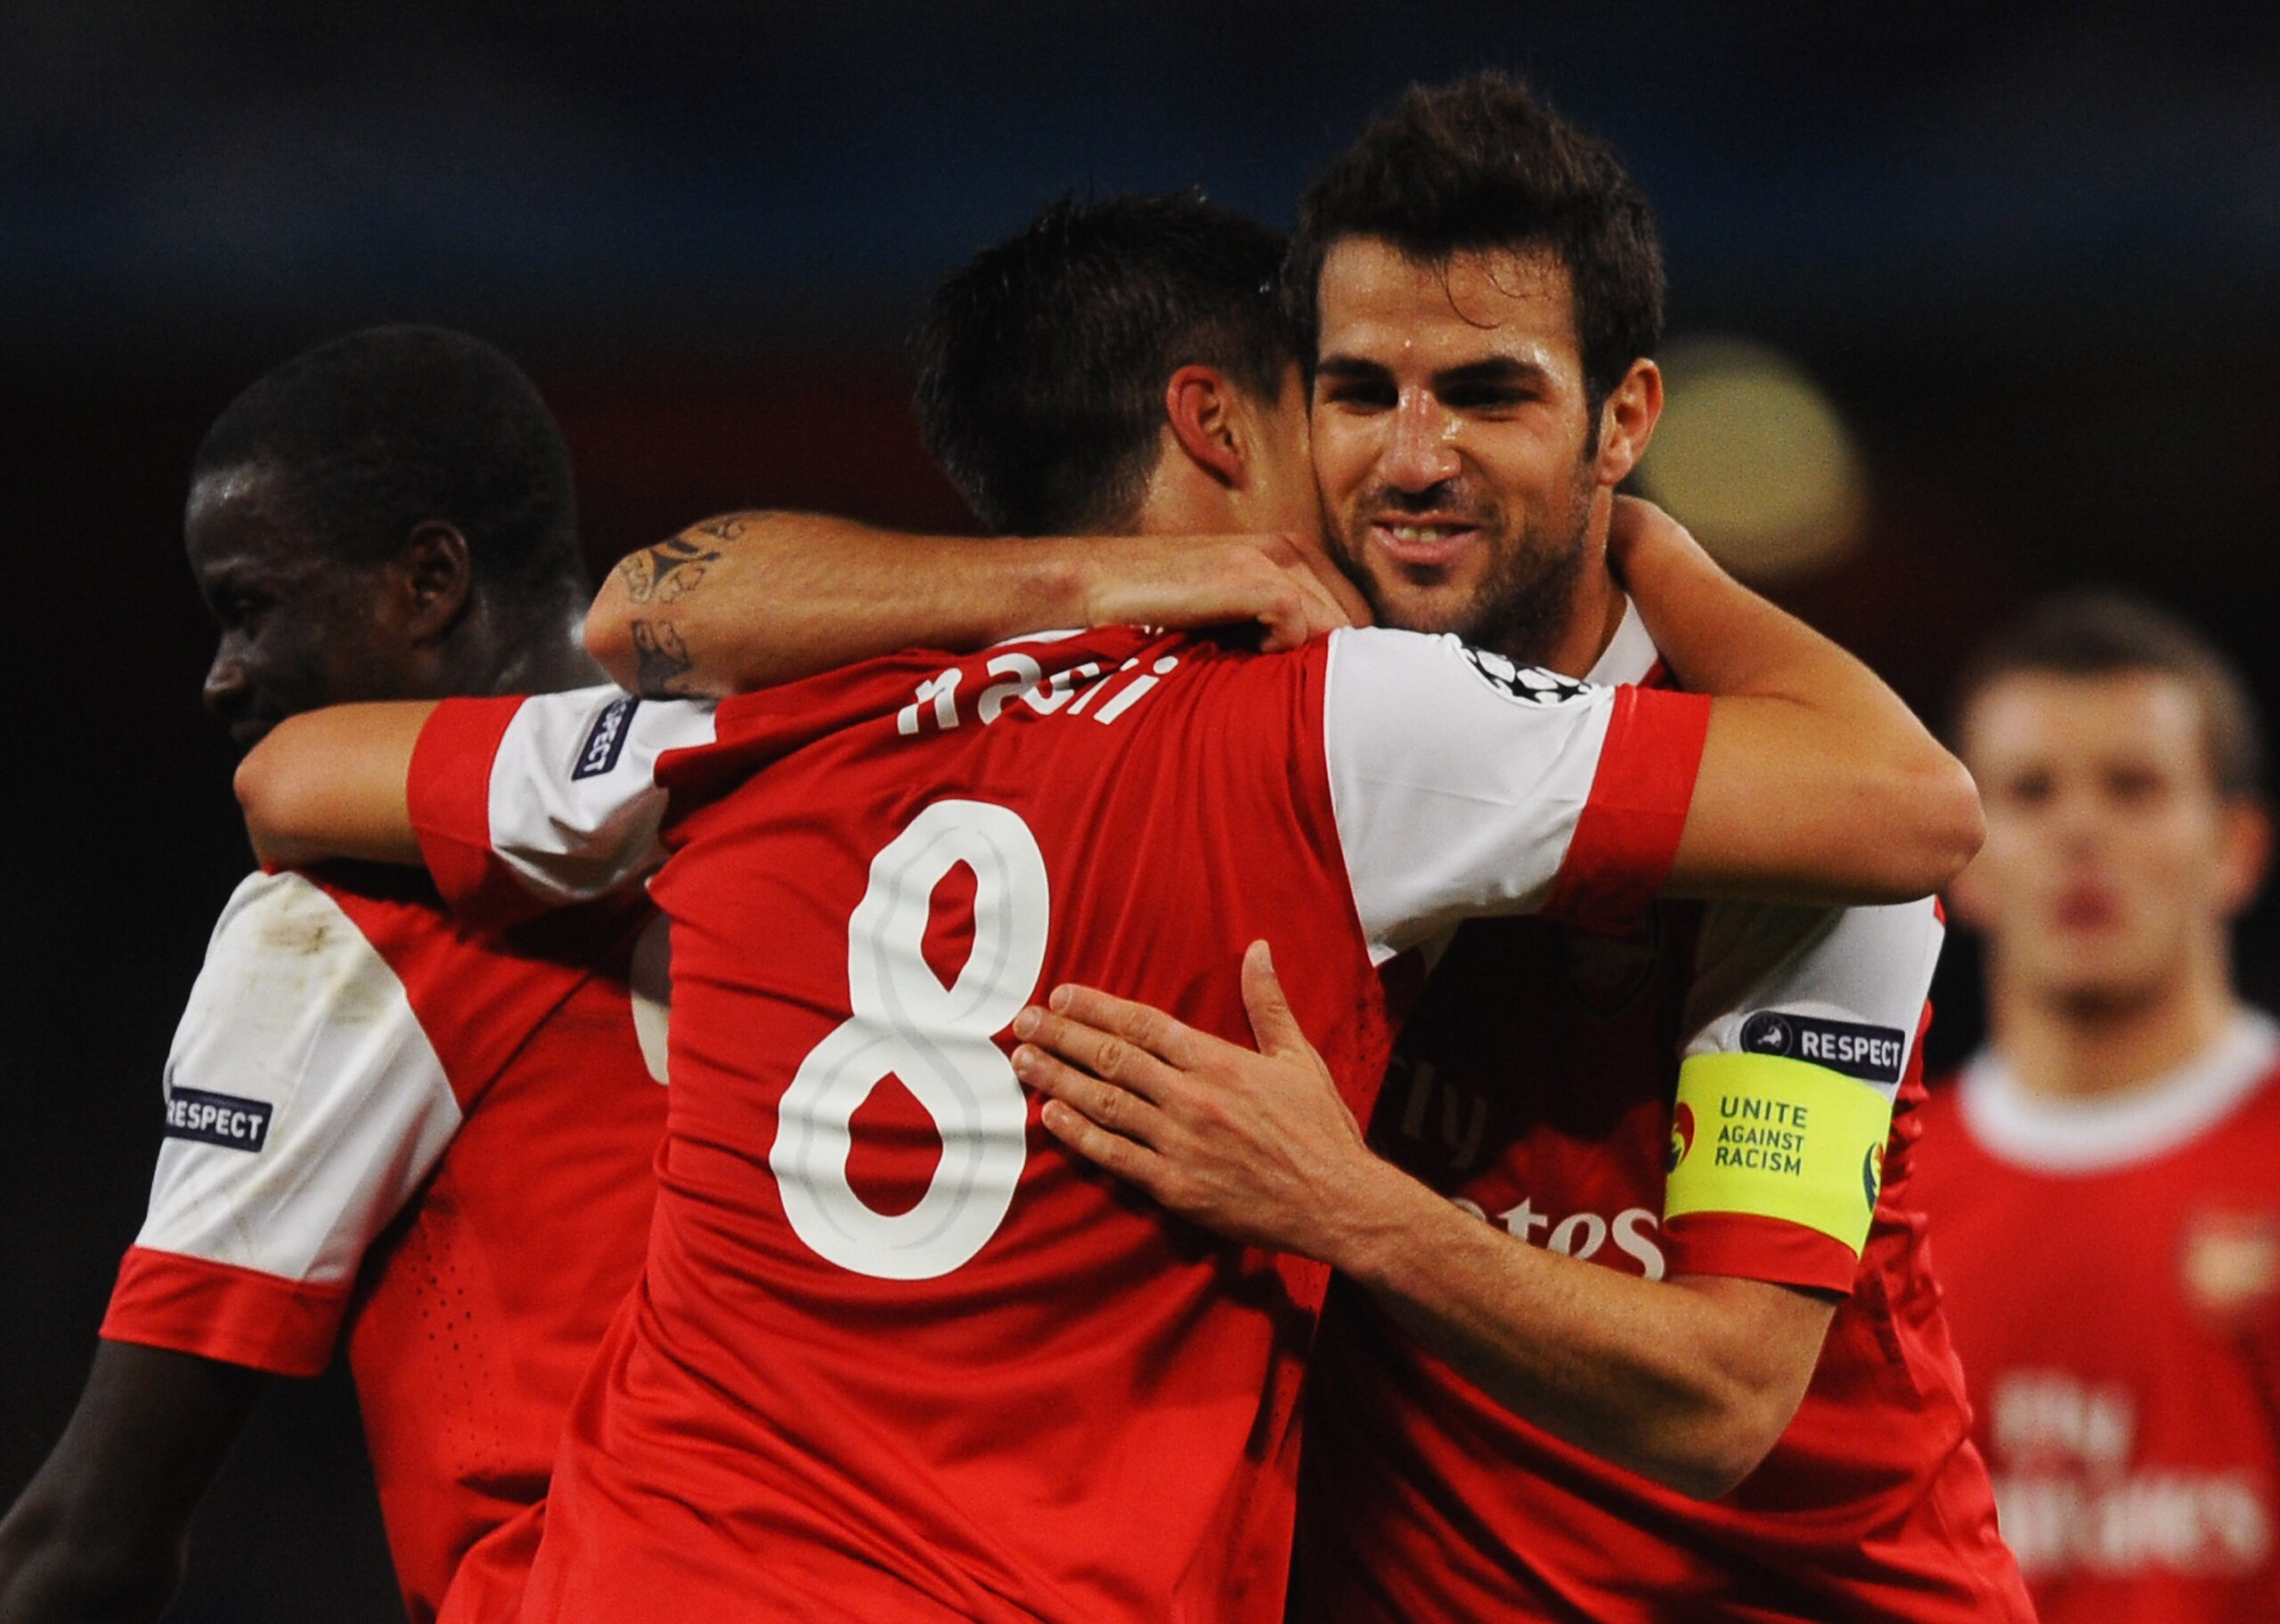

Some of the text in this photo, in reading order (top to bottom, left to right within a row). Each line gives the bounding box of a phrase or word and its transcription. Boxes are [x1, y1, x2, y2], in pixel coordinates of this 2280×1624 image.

[769, 799, 1049, 1280] 8
[1802, 1030, 1901, 1068] RESPECT
[1721, 1097, 1807, 1130] UNITE
[1717, 1125, 1804, 1153] AGAINST
[1714, 1145, 1802, 1177] RACISM
[1449, 1197, 1665, 1281] tes
